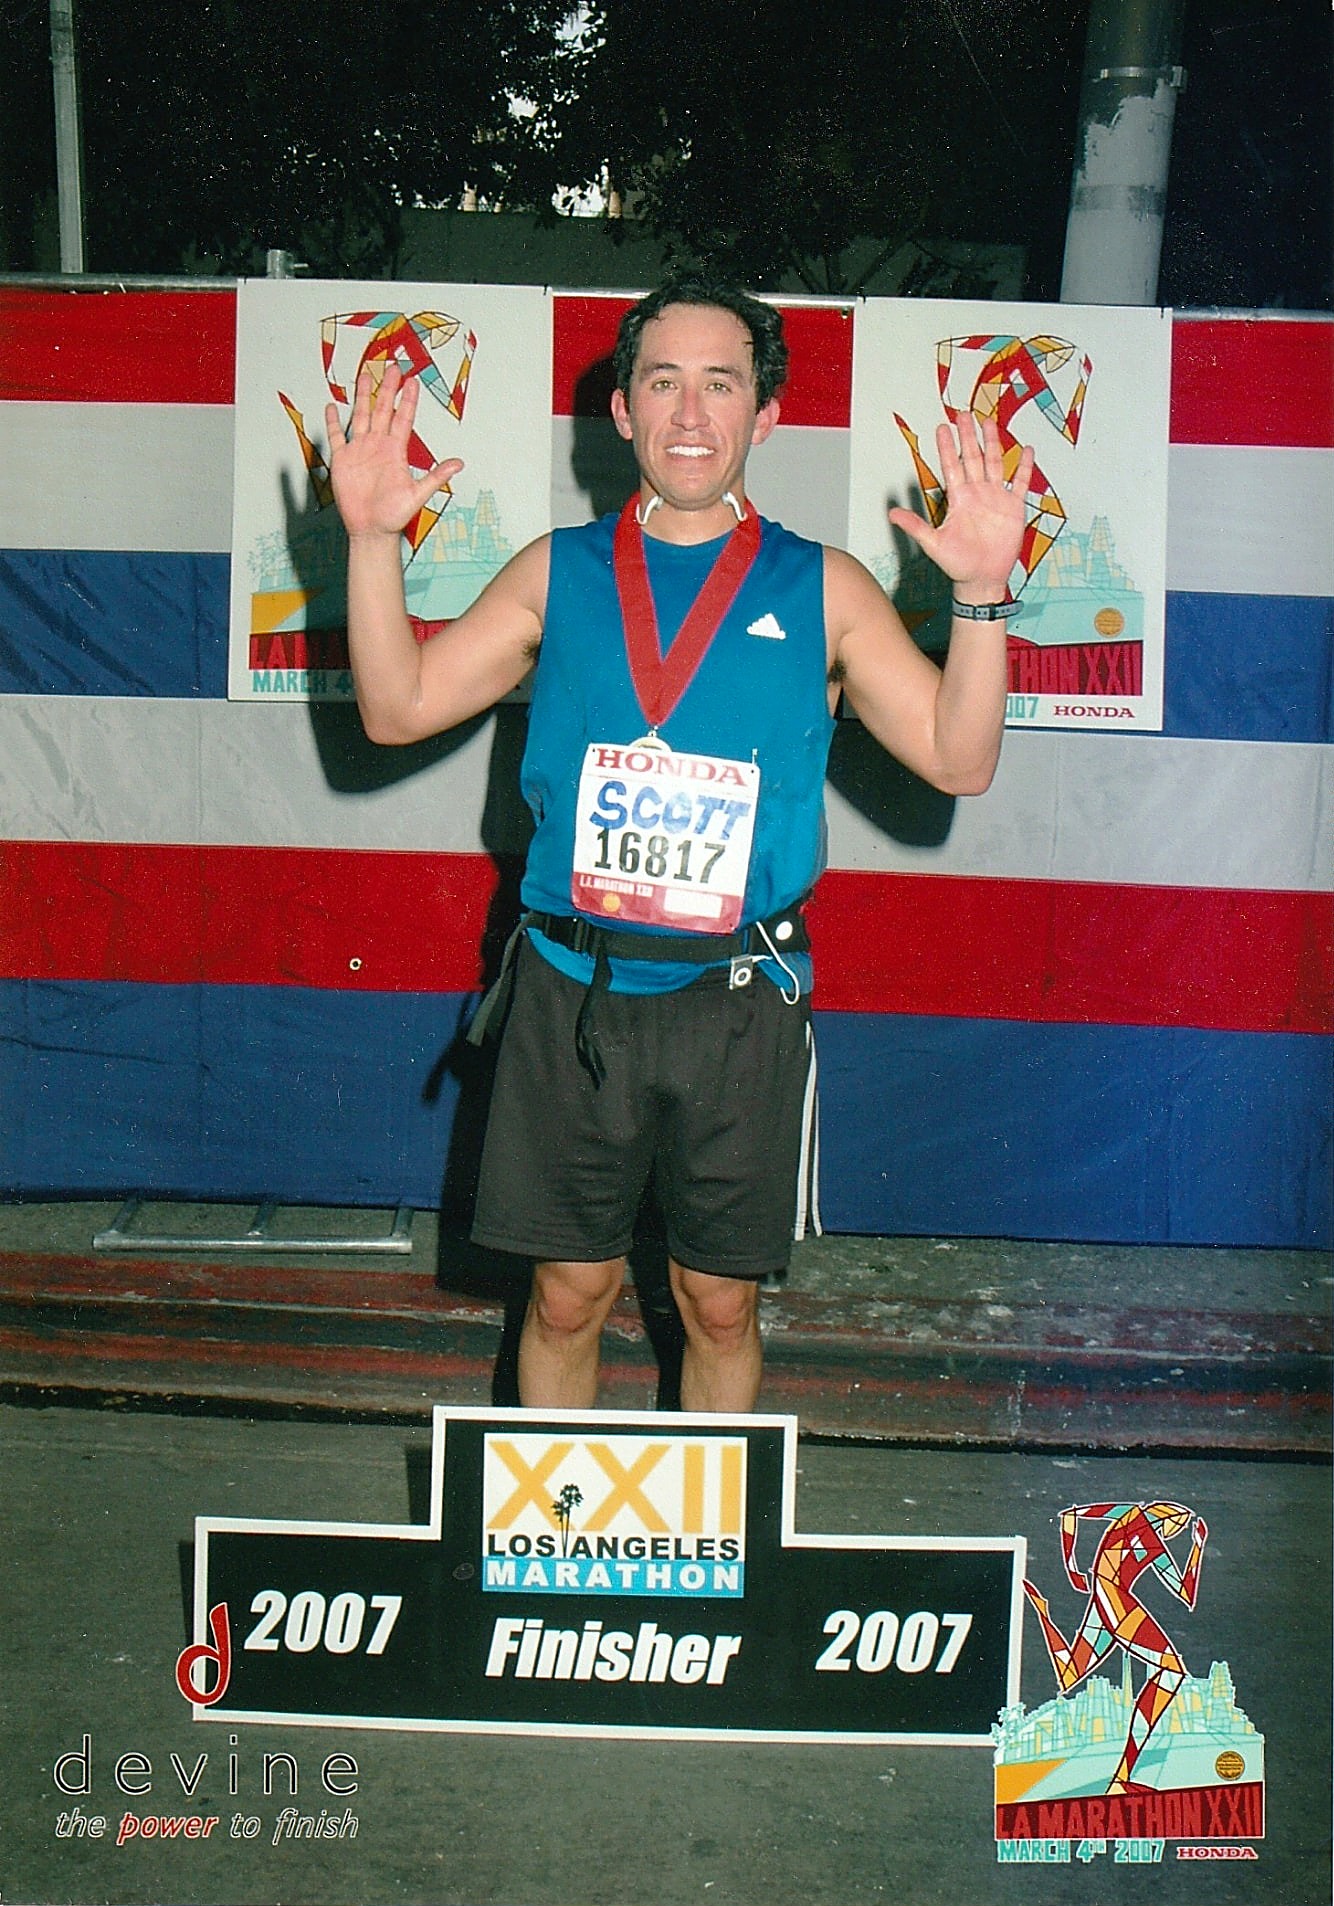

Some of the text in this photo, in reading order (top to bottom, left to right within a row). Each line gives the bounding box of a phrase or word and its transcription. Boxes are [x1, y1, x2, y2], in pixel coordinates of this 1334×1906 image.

[252, 670, 351, 693] MARCH 4
[1007, 643, 1142, 695] THON XXII
[1006, 696, 1135, 718] 007 HONDA
[595, 747, 748, 787] HONDA
[589, 780, 752, 841] SCOTT
[594, 828, 726, 884] 16817
[486, 1440, 743, 1534] XXII
[487, 1534, 739, 1561] LOS ANGELES
[486, 1560, 740, 1591] MARATHON
[243, 1589, 403, 1655] 2007
[815, 1609, 974, 1673] 2007
[484, 1617, 743, 1685] Finisher
